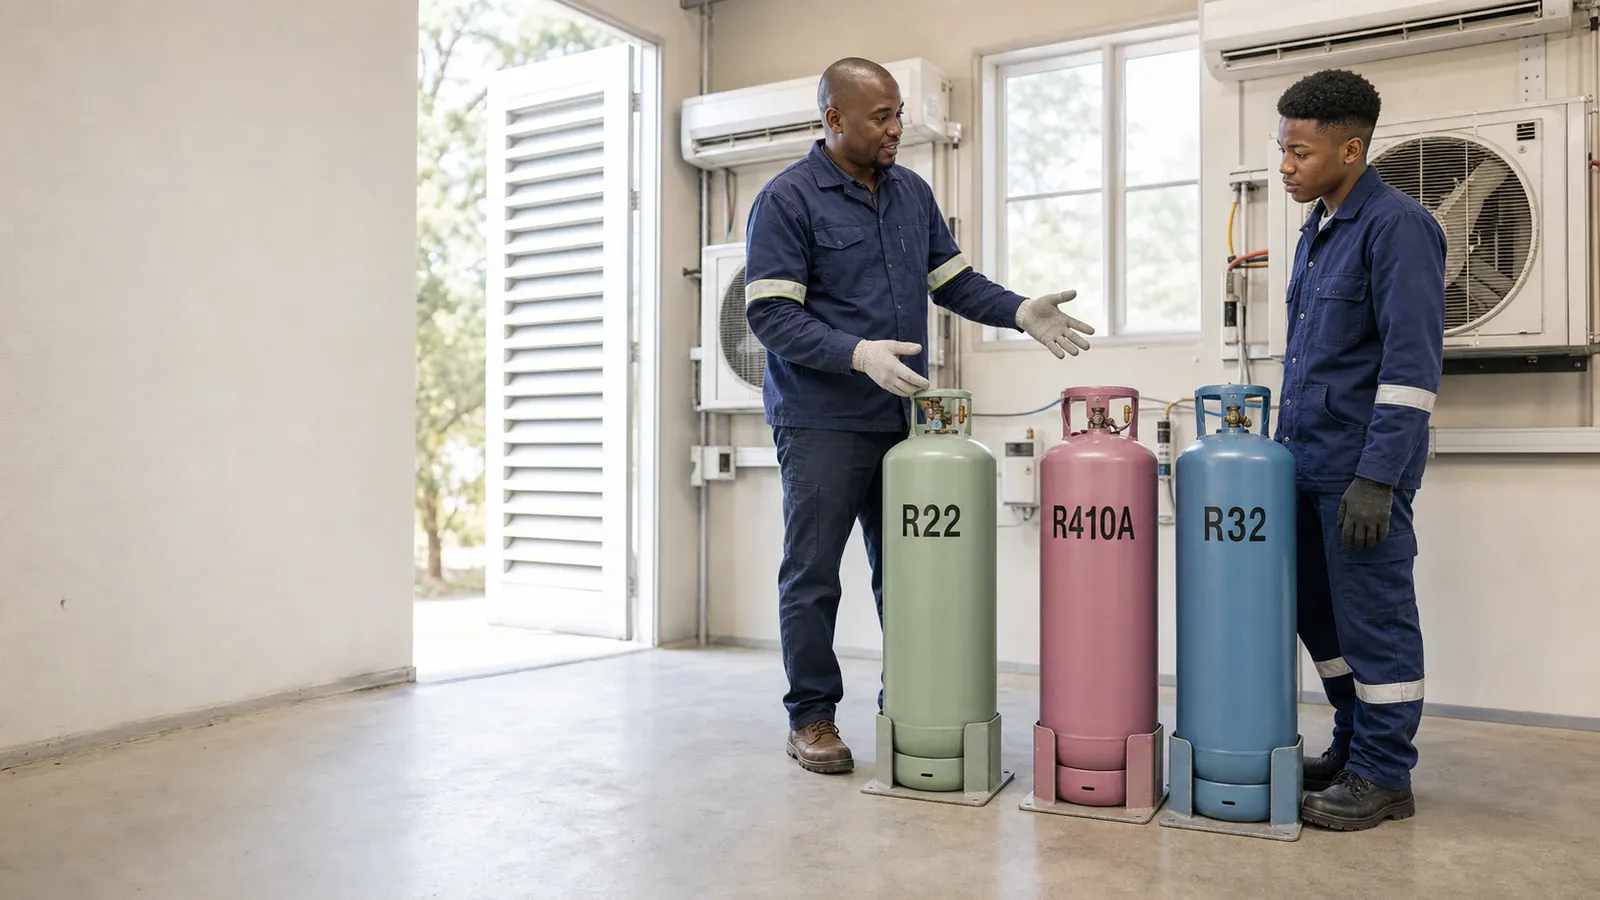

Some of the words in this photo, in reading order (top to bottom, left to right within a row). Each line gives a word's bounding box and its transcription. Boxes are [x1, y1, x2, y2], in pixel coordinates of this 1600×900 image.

[902, 504, 961, 538] R22
[1053, 505, 1136, 541] R410A
[1204, 506, 1267, 542] R32
